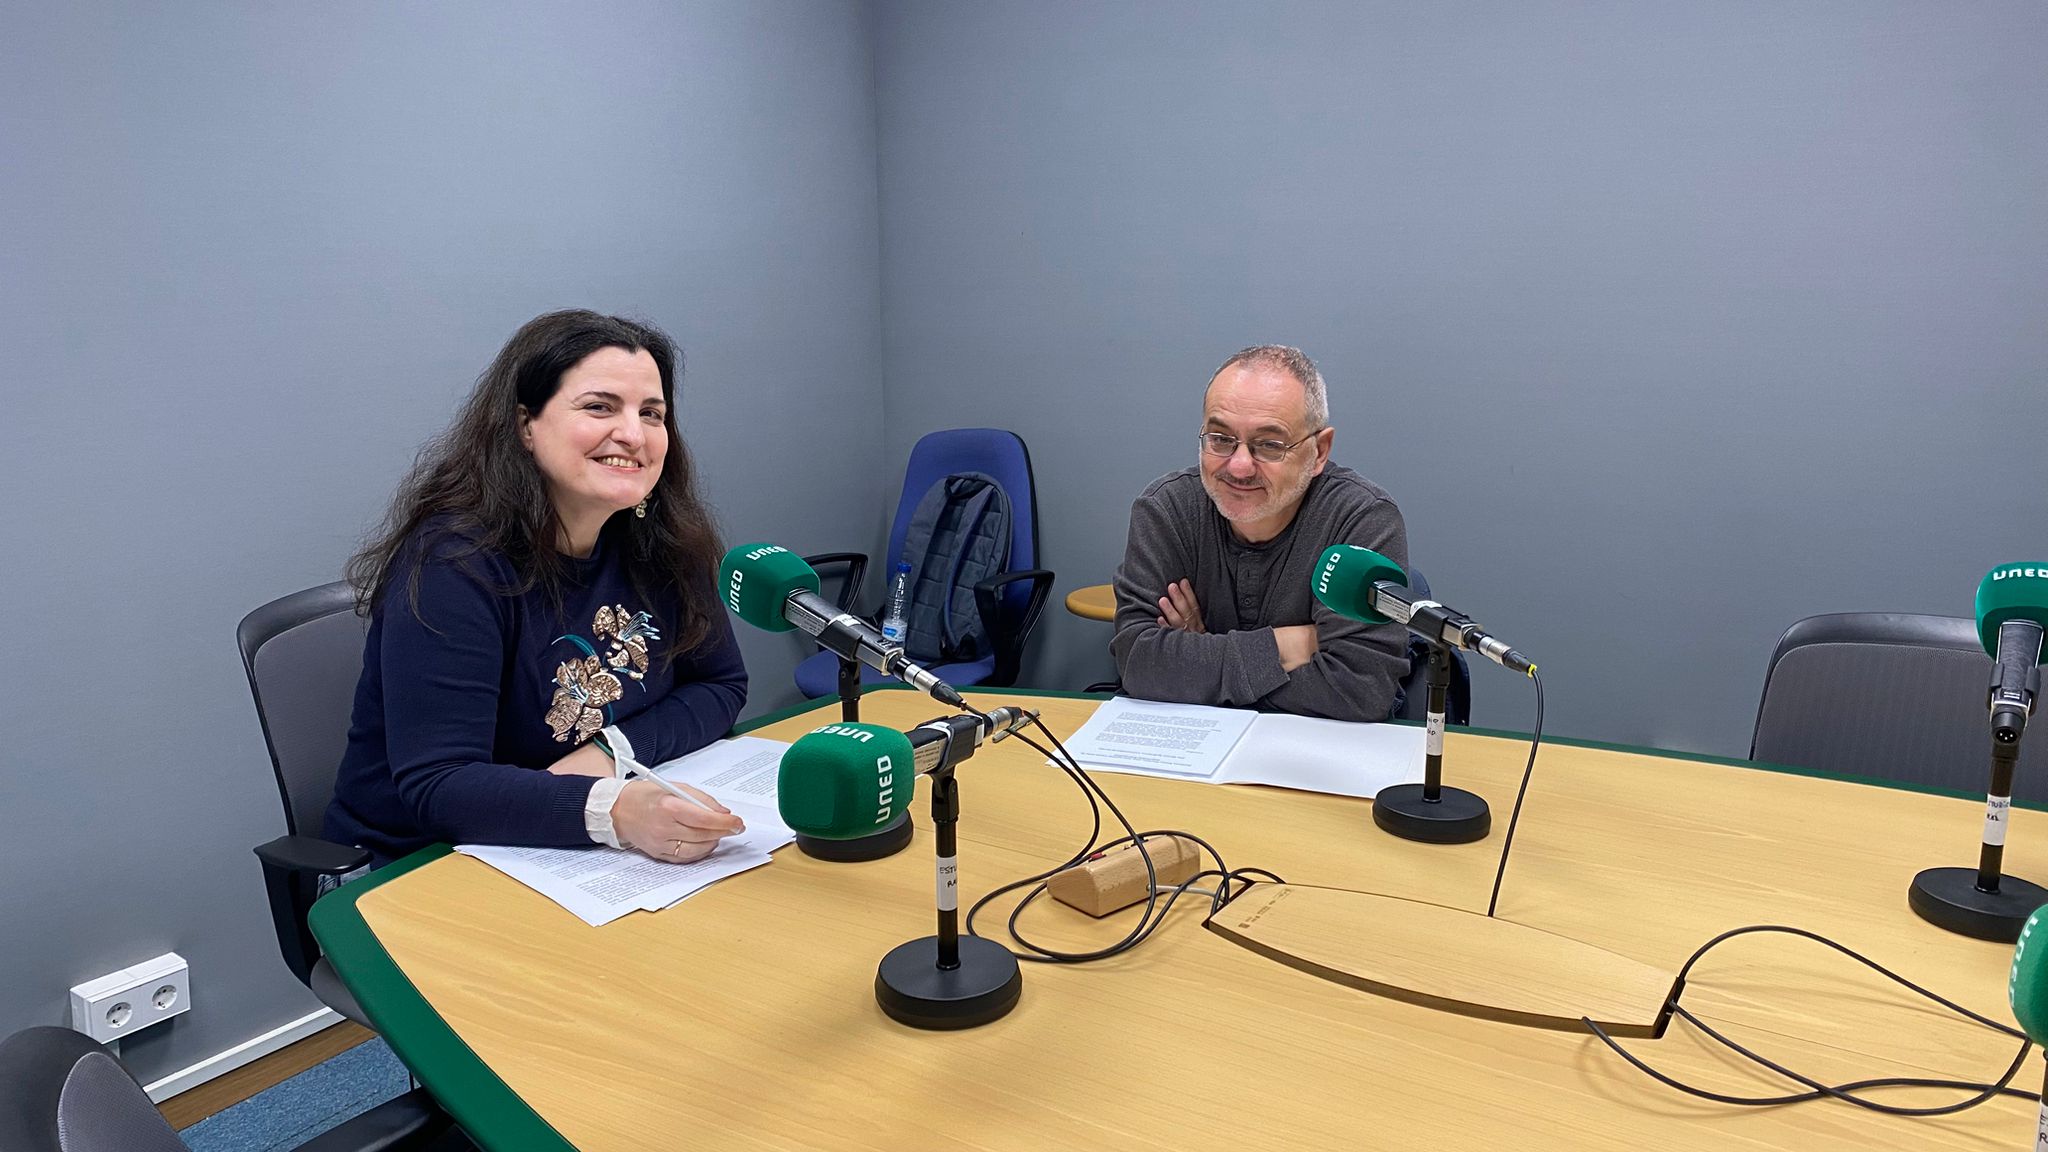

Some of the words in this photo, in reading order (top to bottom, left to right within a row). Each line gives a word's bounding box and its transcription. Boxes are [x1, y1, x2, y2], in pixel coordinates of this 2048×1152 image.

[745, 546, 788, 560] UNED
[1319, 552, 1341, 593] UNED
[1993, 568, 2048, 580] UNED
[730, 569, 743, 613] UNED
[810, 726, 875, 743] UNED
[875, 755, 893, 824] UNED
